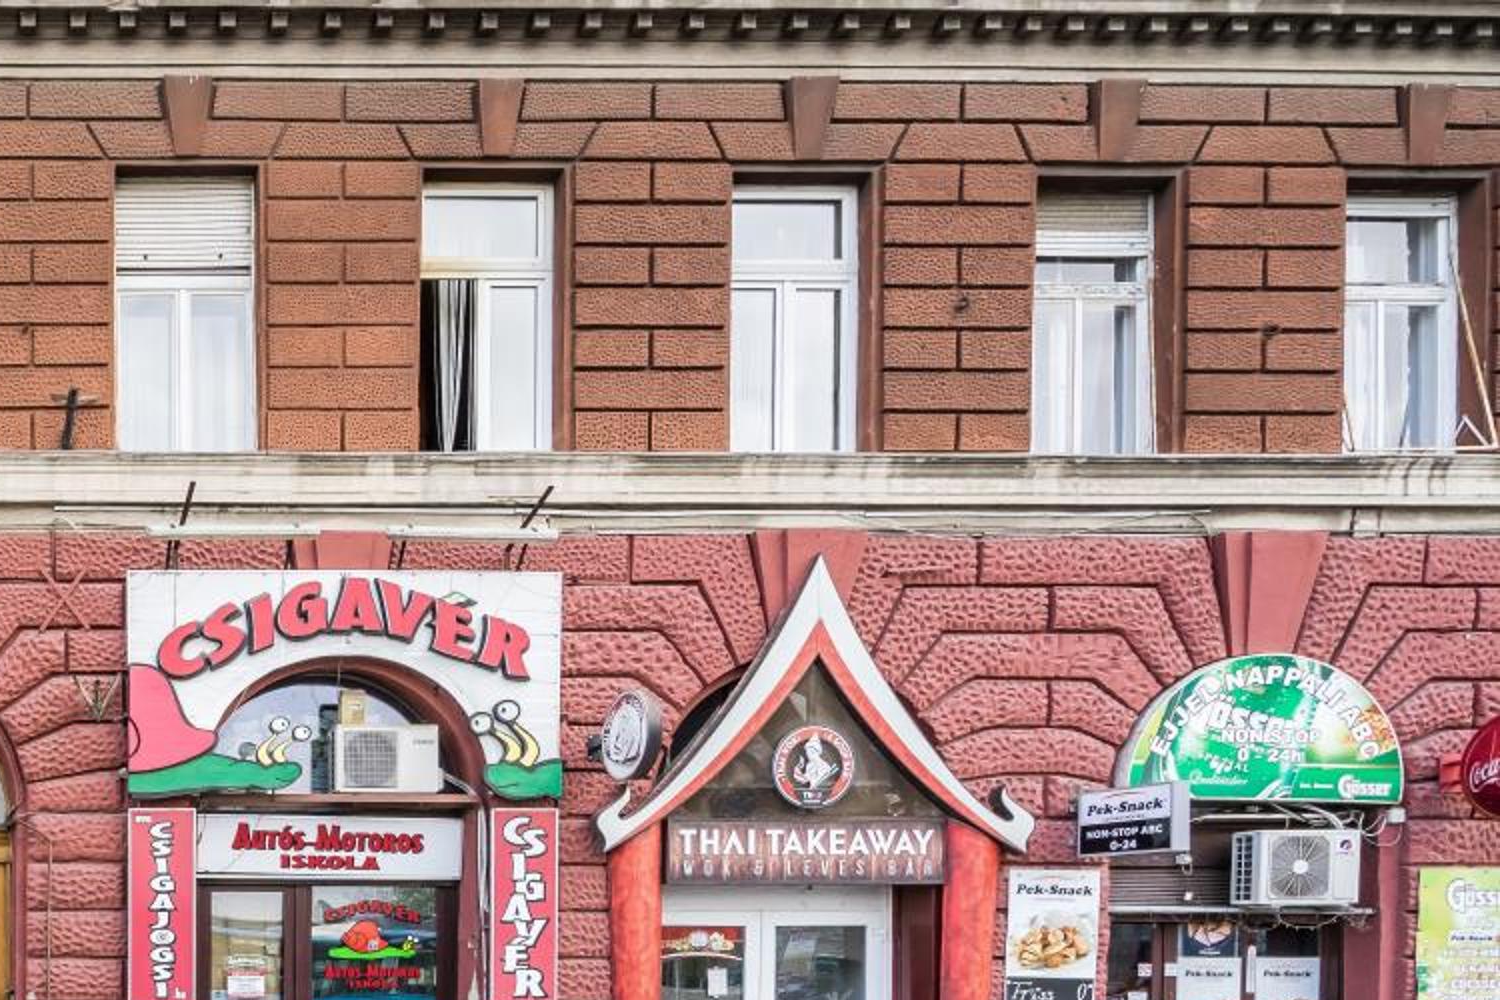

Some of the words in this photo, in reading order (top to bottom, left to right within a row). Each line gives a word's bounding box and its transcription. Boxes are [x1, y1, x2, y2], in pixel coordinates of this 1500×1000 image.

[157, 577, 532, 680] CSIGAVÉR
[1087, 797, 1163, 816] Pek-Snack
[679, 828, 755, 855] THAI
[766, 828, 935, 855] TAKEAWAY
[281, 854, 380, 871] ISKOLA
[1016, 883, 1093, 896] Pek-Snack
[149, 821, 177, 999] CSIGAJOGSI
[502, 816, 549, 999] CSIGAVÉR
